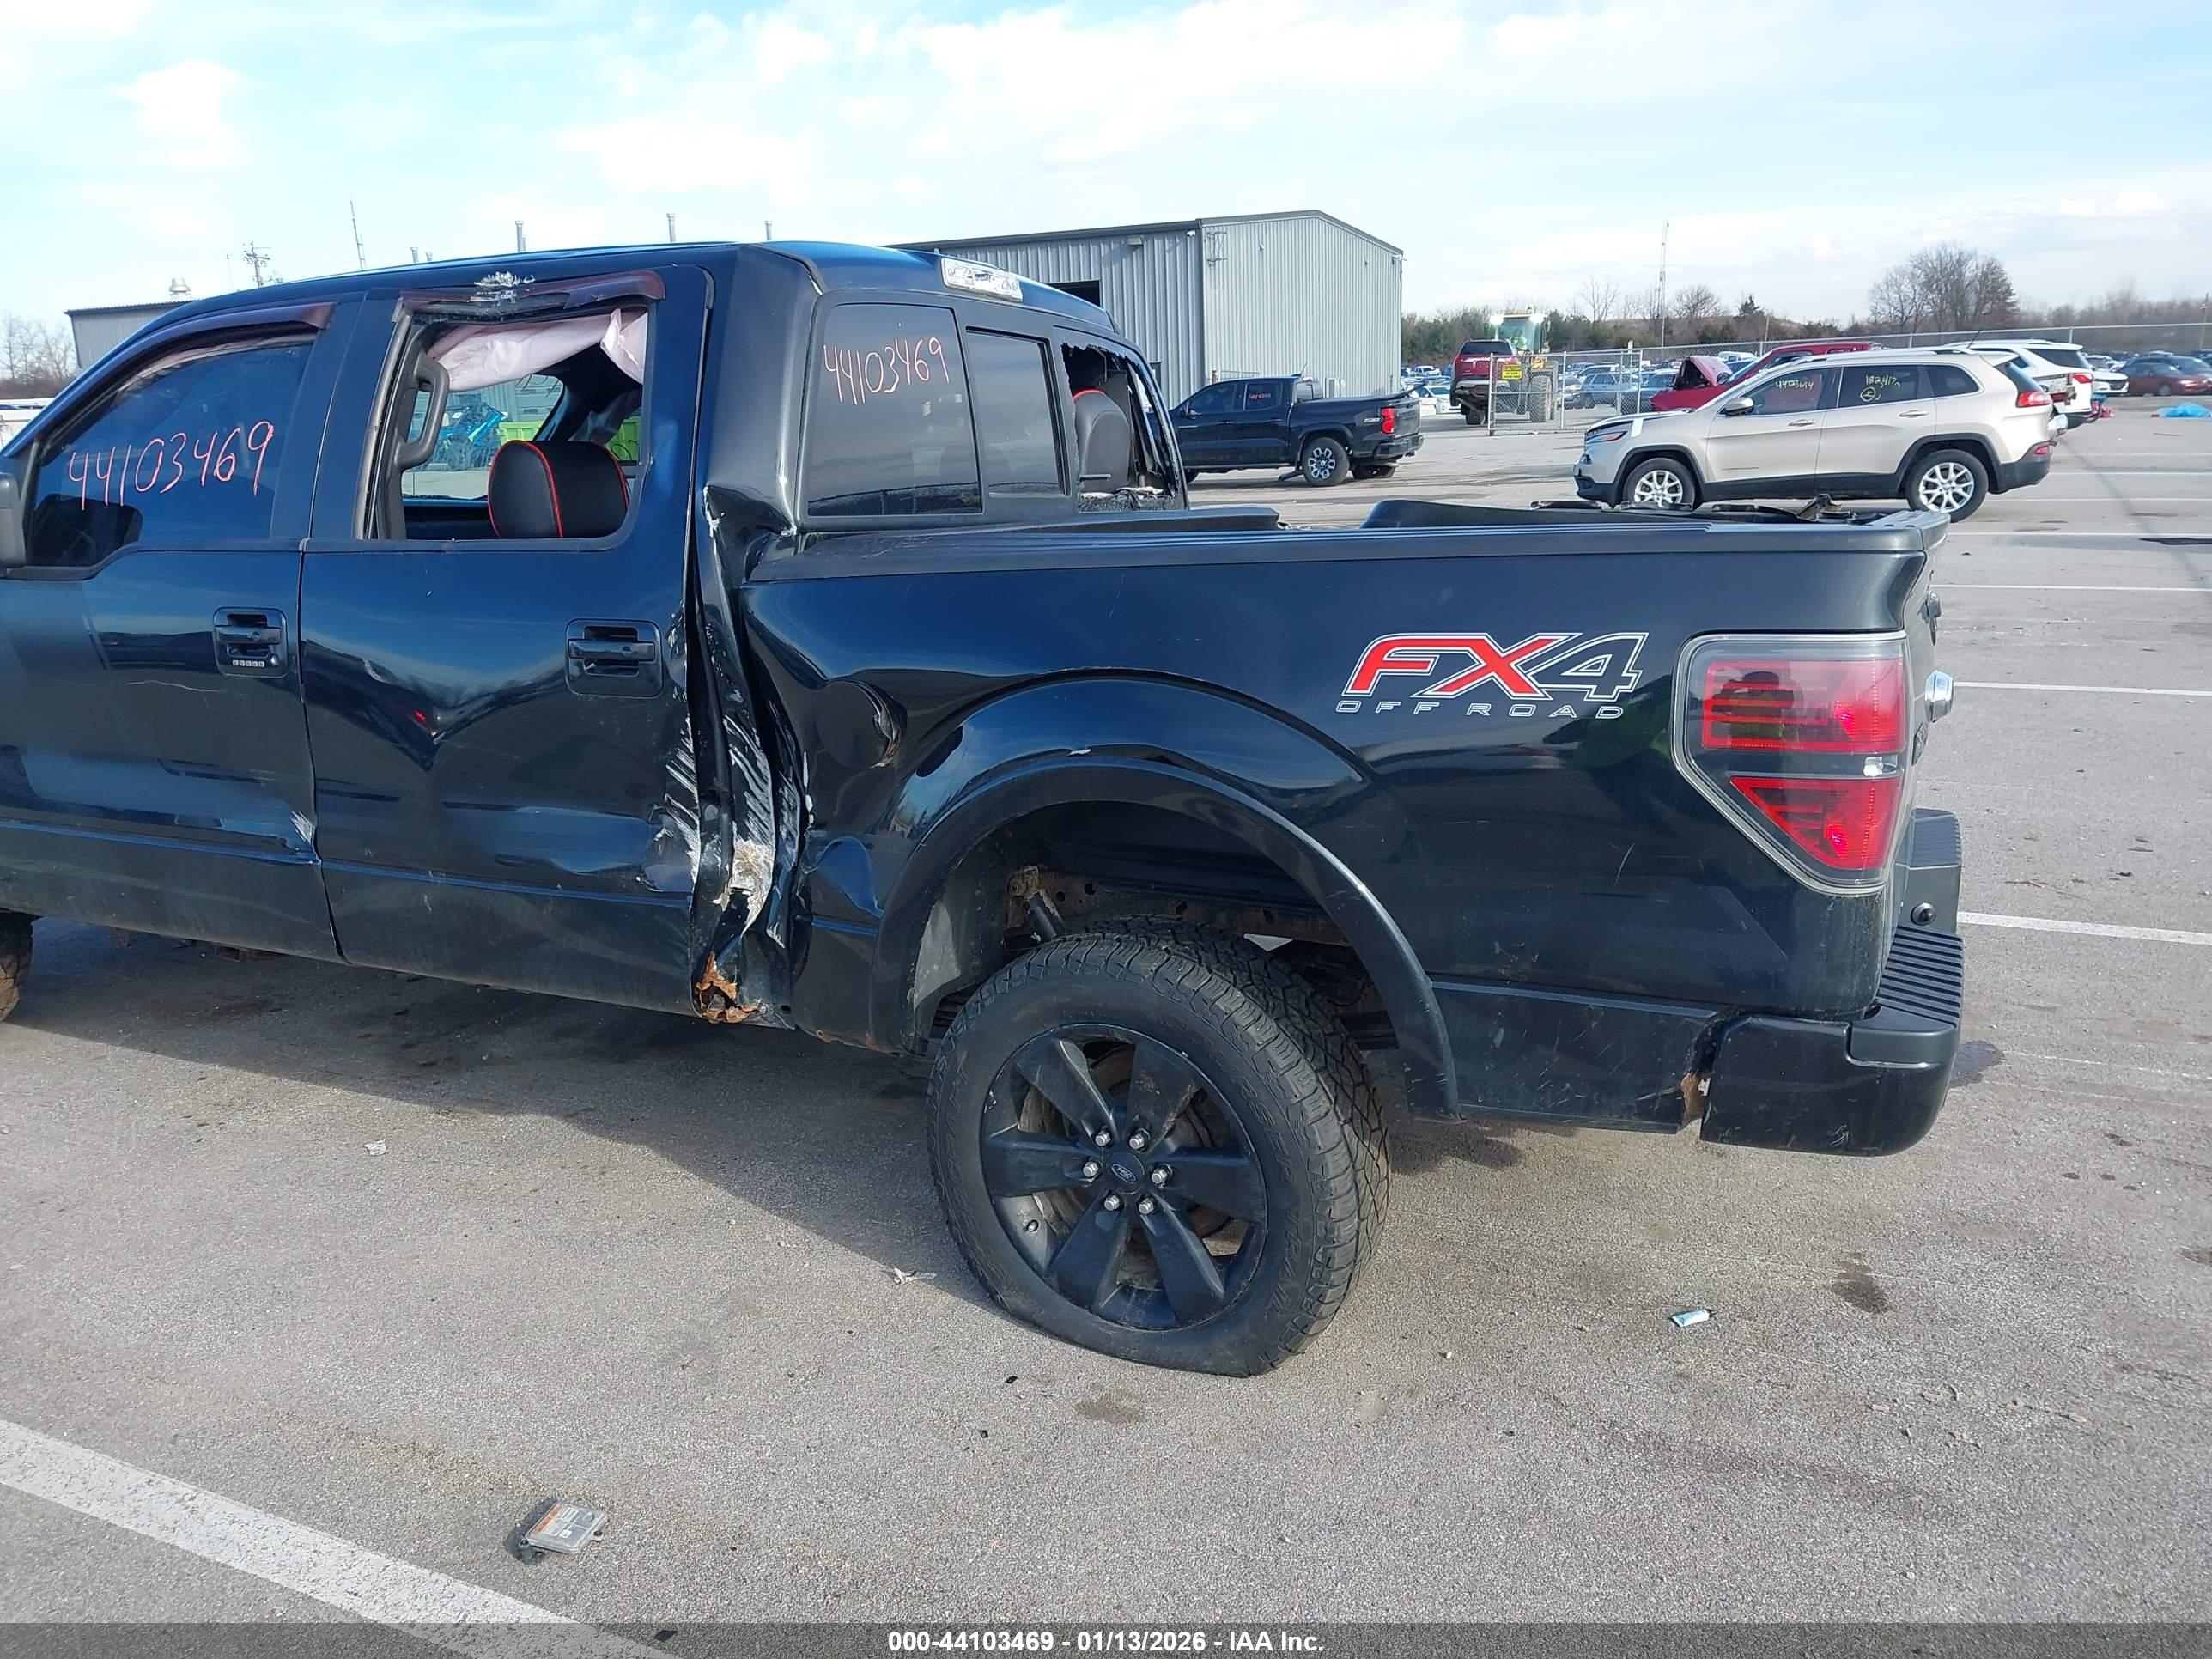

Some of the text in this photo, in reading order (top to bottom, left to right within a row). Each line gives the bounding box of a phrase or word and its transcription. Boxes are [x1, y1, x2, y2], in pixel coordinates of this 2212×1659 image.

[823, 336, 950, 406] 44103469
[68, 420, 274, 511] 44103469
[1341, 632, 1650, 702] FX4
[1335, 701, 1623, 719] OFF ROAD
